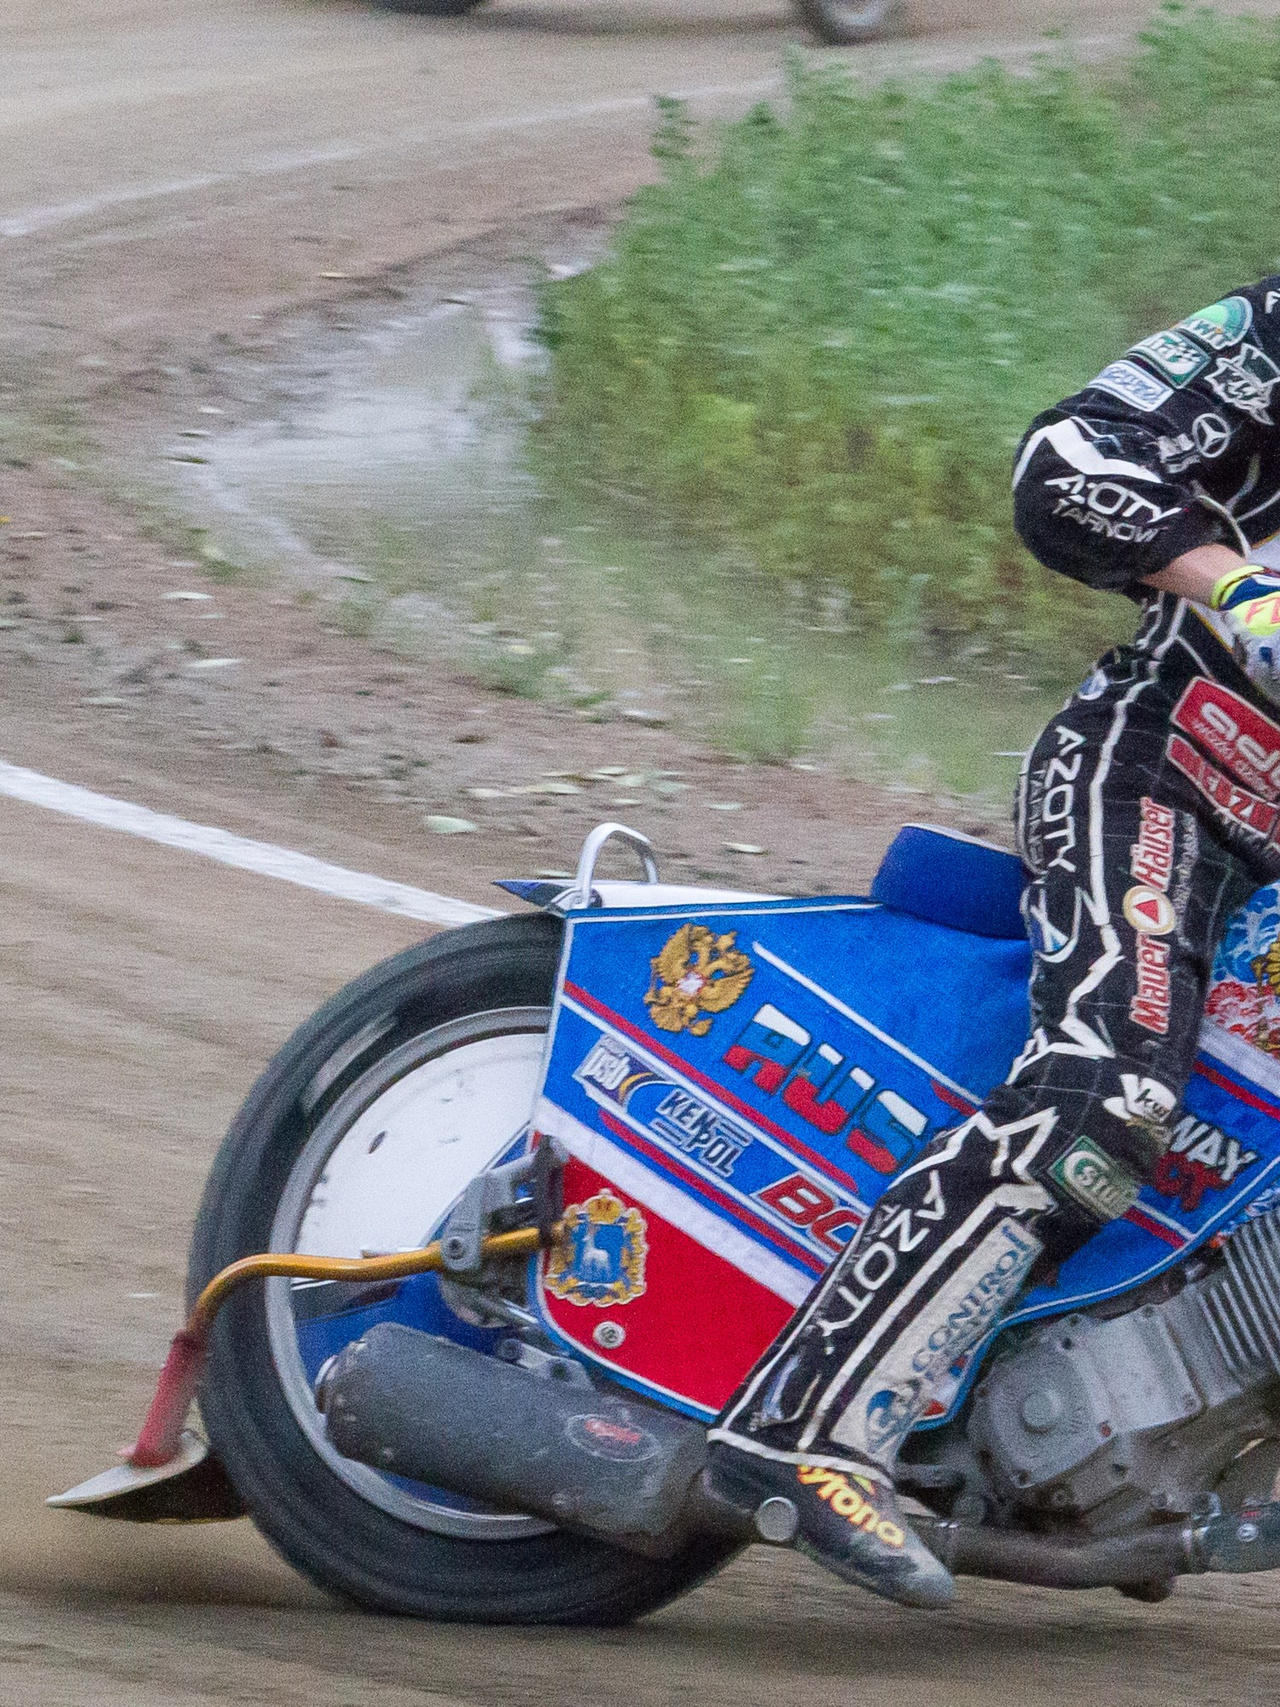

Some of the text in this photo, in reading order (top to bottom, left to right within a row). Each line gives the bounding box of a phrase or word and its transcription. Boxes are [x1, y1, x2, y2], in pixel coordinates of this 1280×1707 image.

[1043, 725, 1087, 873] AZOTY
[1130, 797, 1174, 1034] Mauer Häuser
[812, 1169, 947, 1354] AZOTY
[799, 1464, 904, 1548] ytona
